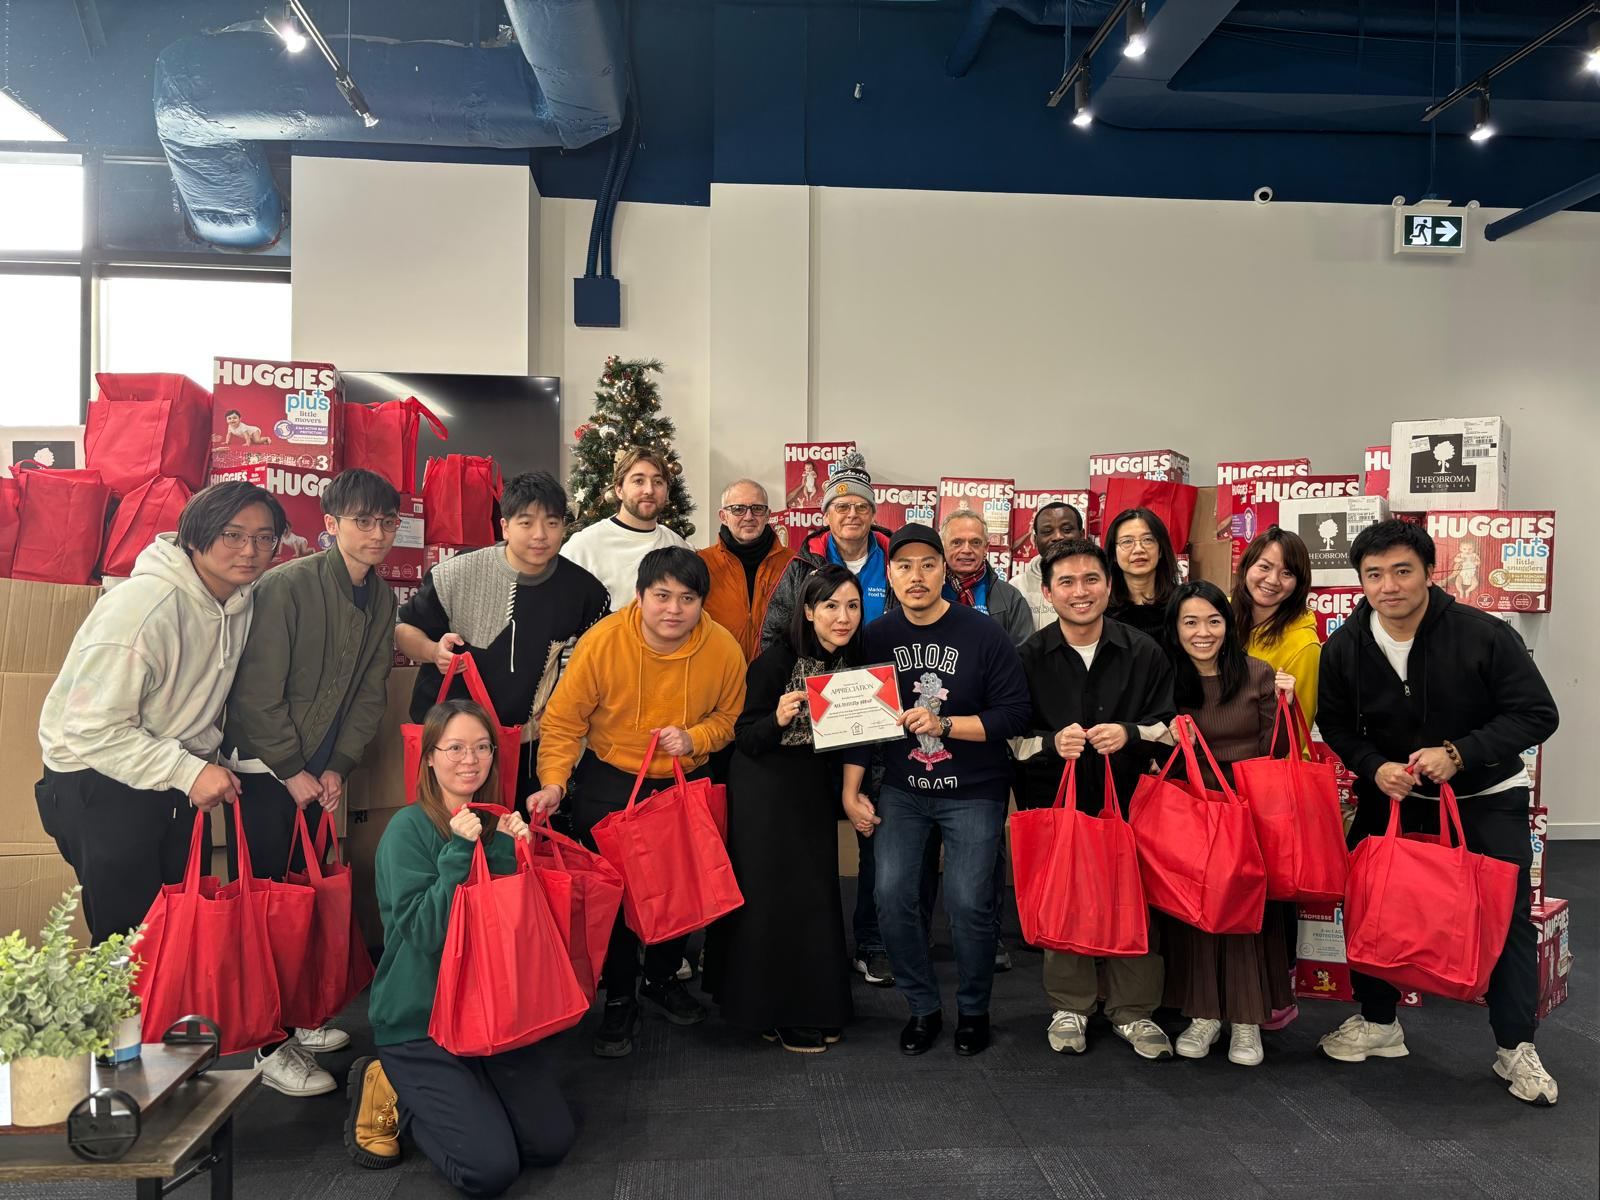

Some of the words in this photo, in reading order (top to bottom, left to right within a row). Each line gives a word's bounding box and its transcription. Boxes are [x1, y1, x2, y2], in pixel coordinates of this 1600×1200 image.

[213, 360, 335, 391] HUGGIES
[316, 455, 329, 471] 3
[1090, 454, 1171, 476] HUGGIES
[1415, 475, 1471, 484] THEOBROMA
[874, 487, 937, 506] UGGIES
[940, 480, 1014, 500] HUGGIES
[789, 511, 829, 528] HUG
[1427, 515, 1554, 539] HUGGIES
[1308, 552, 1350, 560] HEOBROM
[1536, 594, 1546, 611] 1
[893, 643, 959, 675] DIOR
[1532, 888, 1541, 905] 1
[1404, 992, 1419, 1005] 3
